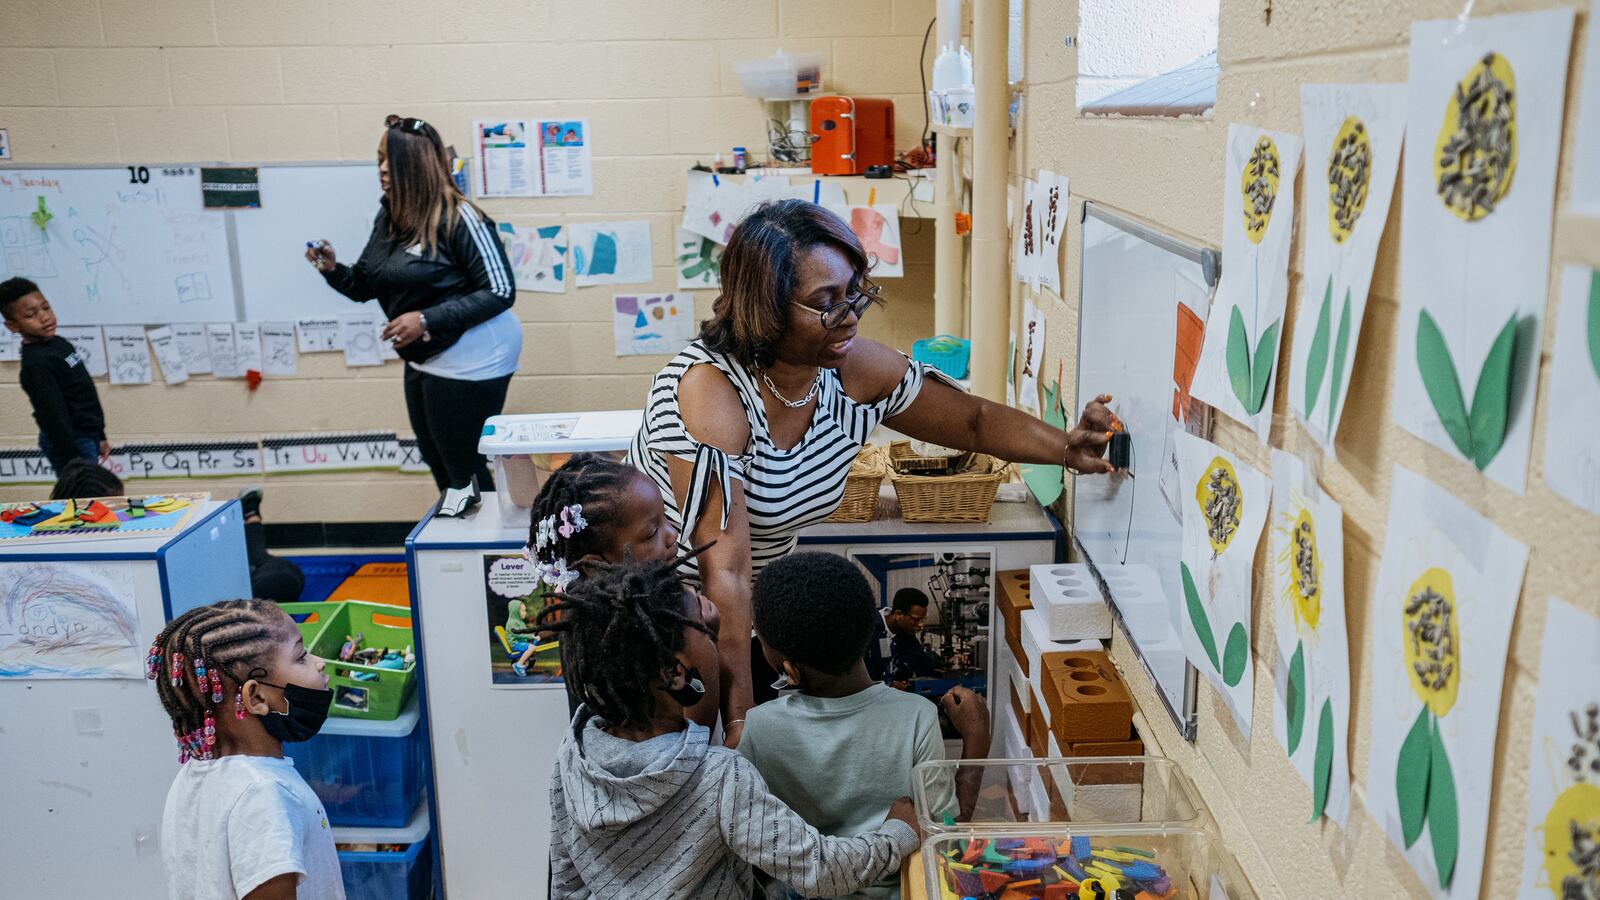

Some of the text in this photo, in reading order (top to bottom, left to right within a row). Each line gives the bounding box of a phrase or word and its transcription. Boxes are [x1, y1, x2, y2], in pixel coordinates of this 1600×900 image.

[127, 166, 150, 184] 10
[129, 453, 154, 478] Pp
[161, 452, 191, 478] Qq
[199, 450, 221, 470] Rr
[232, 450, 255, 468] Ss
[269, 441, 398, 465] Tt Uu Vv Ww
